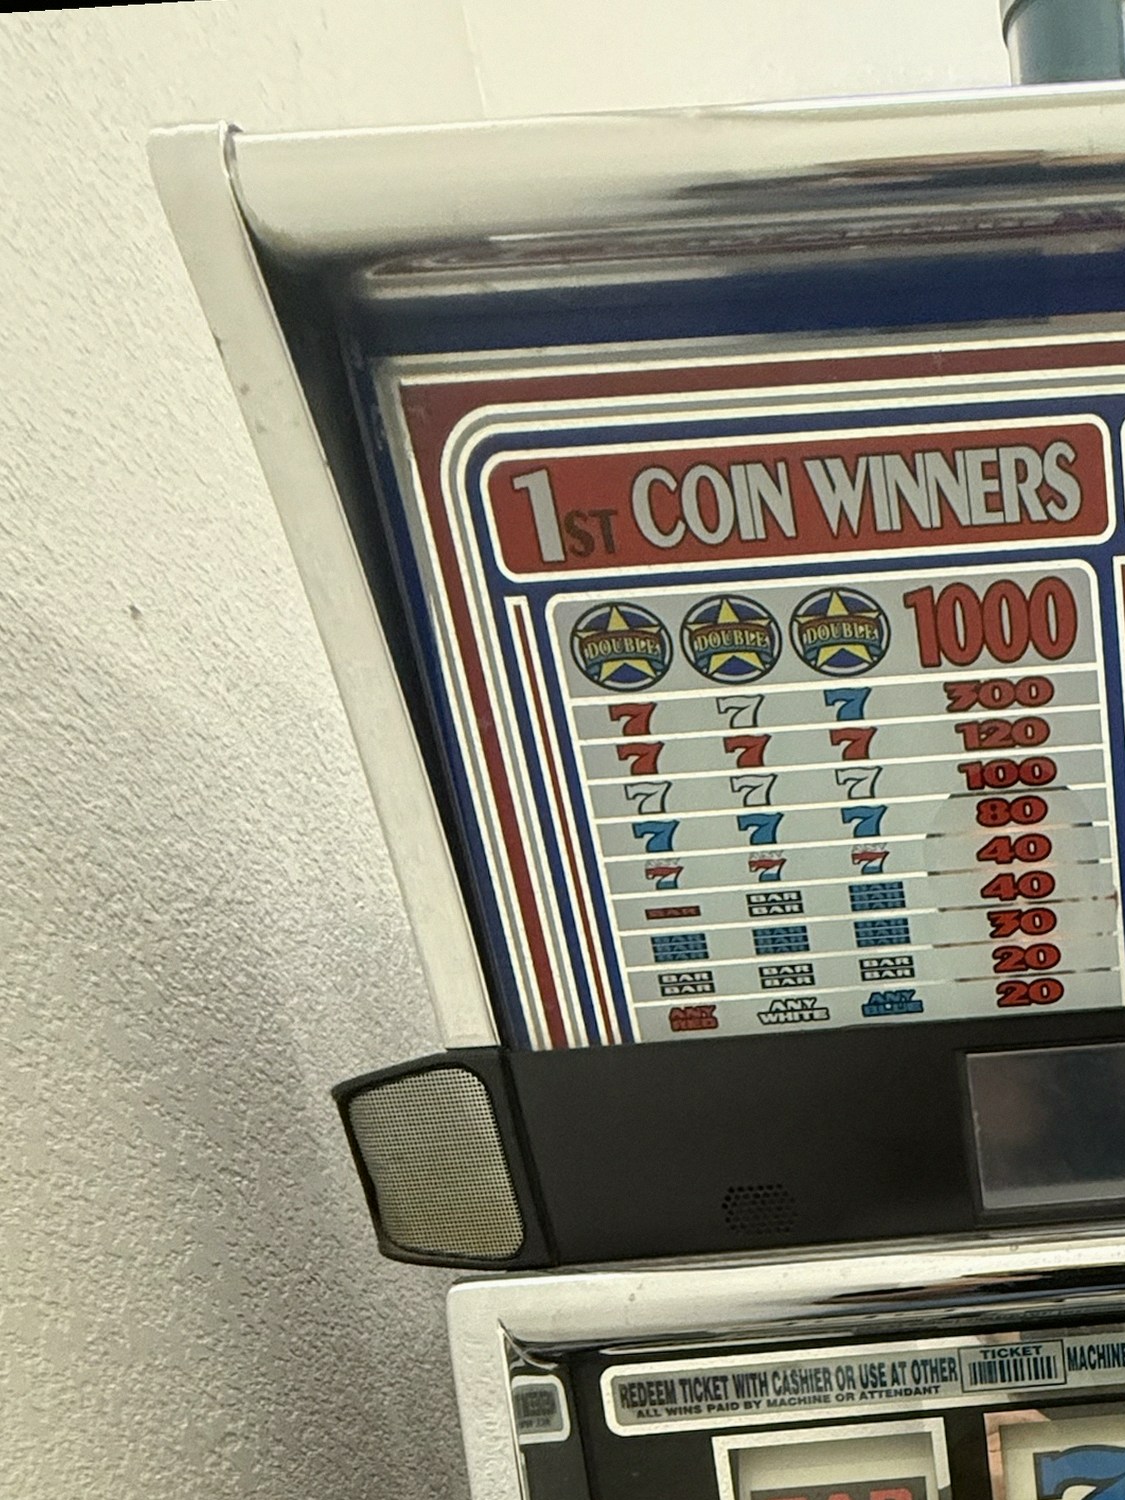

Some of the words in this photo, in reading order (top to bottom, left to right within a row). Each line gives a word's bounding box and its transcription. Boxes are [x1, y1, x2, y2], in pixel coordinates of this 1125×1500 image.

[630, 461, 796, 549] COIN
[804, 440, 1083, 537] WINNERS
[586, 637, 657, 656] DOUBLE
[696, 630, 768, 650] DOUBLE
[805, 622, 876, 644] DOUBLE
[903, 575, 1078, 669] 1000
[608, 701, 657, 736] 7
[716, 694, 765, 729] 7
[823, 687, 872, 720] 7
[943, 675, 1054, 712] 300
[954, 716, 1050, 750] 120
[958, 756, 1057, 790] 100
[976, 795, 1048, 827] 80
[976, 833, 1052, 865] 40
[749, 892, 799, 904] BAR
[980, 870, 1055, 901] 40
[751, 904, 801, 915] BAR
[987, 907, 1057, 938] 30
[992, 943, 1061, 973] 20
[769, 997, 817, 1011] ANY
[996, 977, 1064, 1008] 20
[757, 1007, 830, 1025] WHITE
[980, 1345, 1042, 1359] TICKET
[618, 1378, 677, 1409] REDEEM
[679, 1375, 729, 1403] TICKET
[732, 1371, 768, 1399] WITH
[772, 1367, 833, 1396] CASHIER
[835, 1365, 856, 1391] OR
[859, 1362, 887, 1389] USE
[891, 1361, 907, 1387] AT
[911, 1357, 958, 1385] OTHER
[637, 1410, 661, 1418] ALL
[666, 1406, 702, 1416] WINS
[707, 1402, 739, 1413] PAID
[744, 1401, 761, 1410] BY
[767, 1394, 830, 1407] MACHINE
[835, 1392, 855, 1401] OR
[859, 1385, 941, 1400] ATTENDANT
